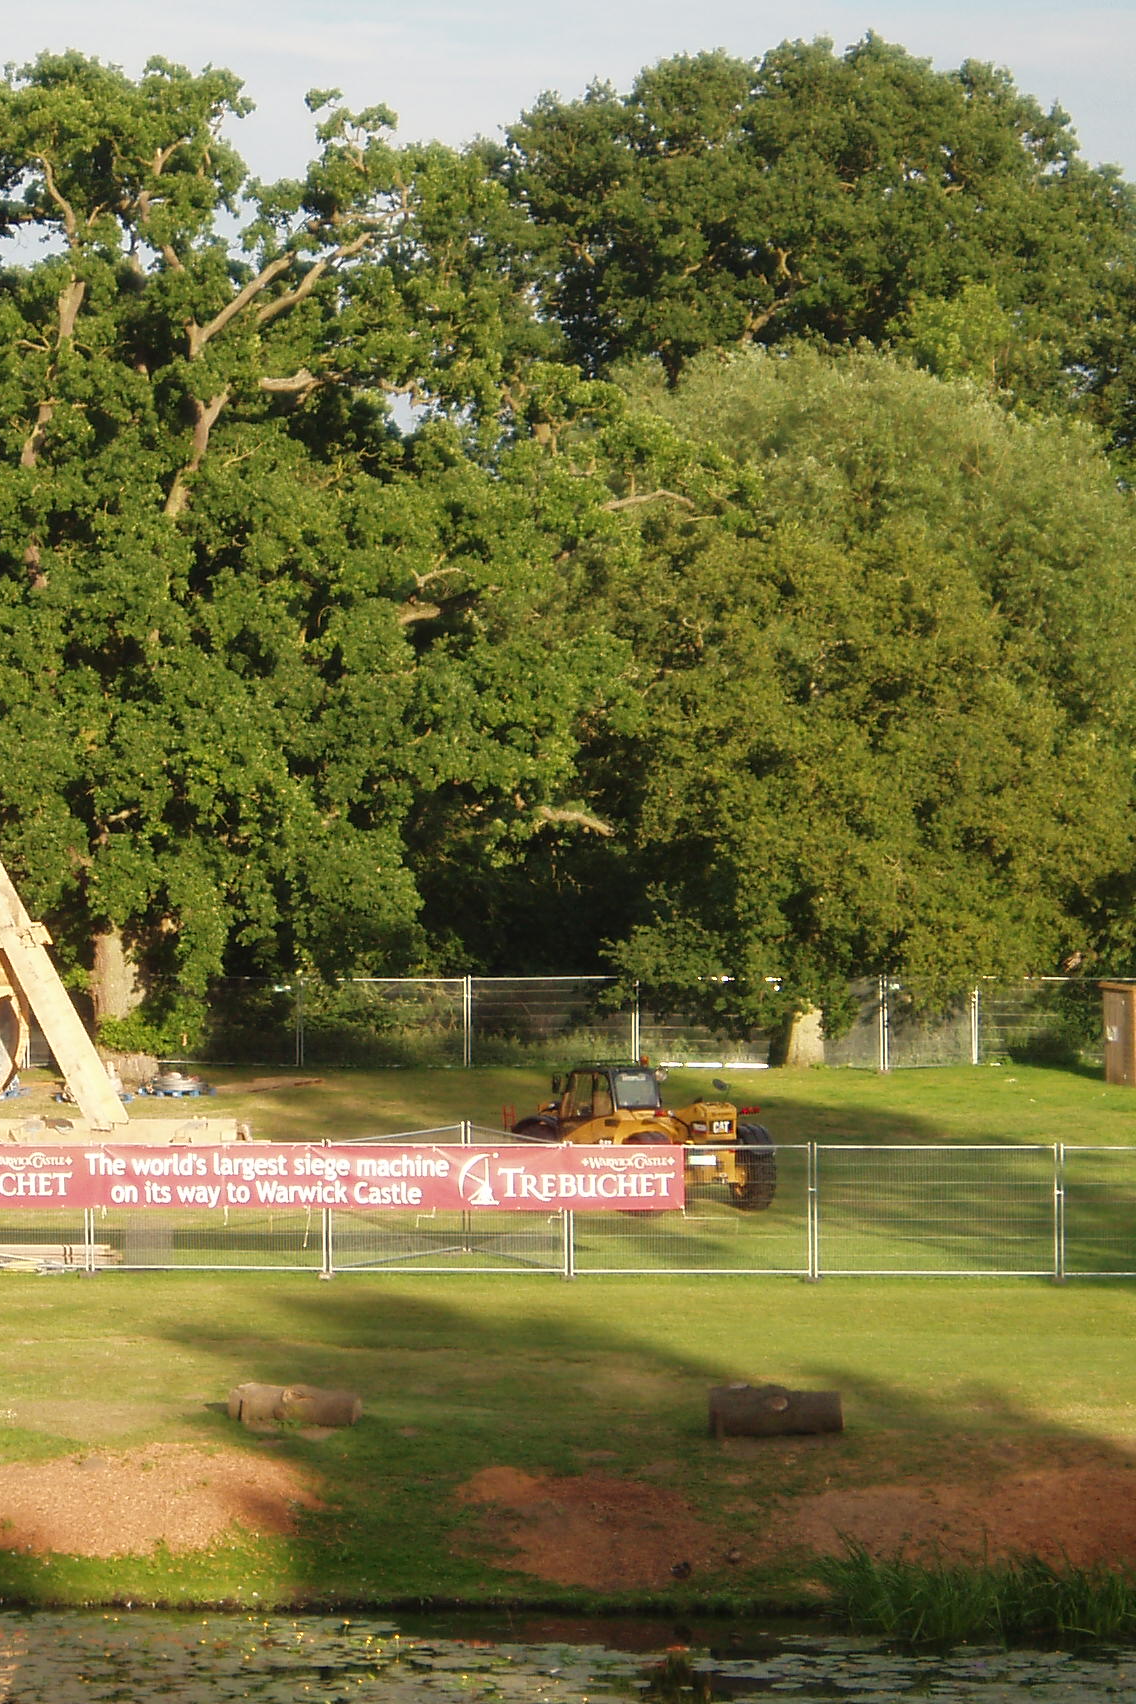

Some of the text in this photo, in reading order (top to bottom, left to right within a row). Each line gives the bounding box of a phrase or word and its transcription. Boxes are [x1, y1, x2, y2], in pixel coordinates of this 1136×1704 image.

[713, 1120, 730, 1134] CAT
[84, 1152, 449, 1181] The world's largest siege machine
[111, 1180, 422, 1208] on its way to Warwick Castle
[497, 1166, 676, 1202] TREBUCHET
